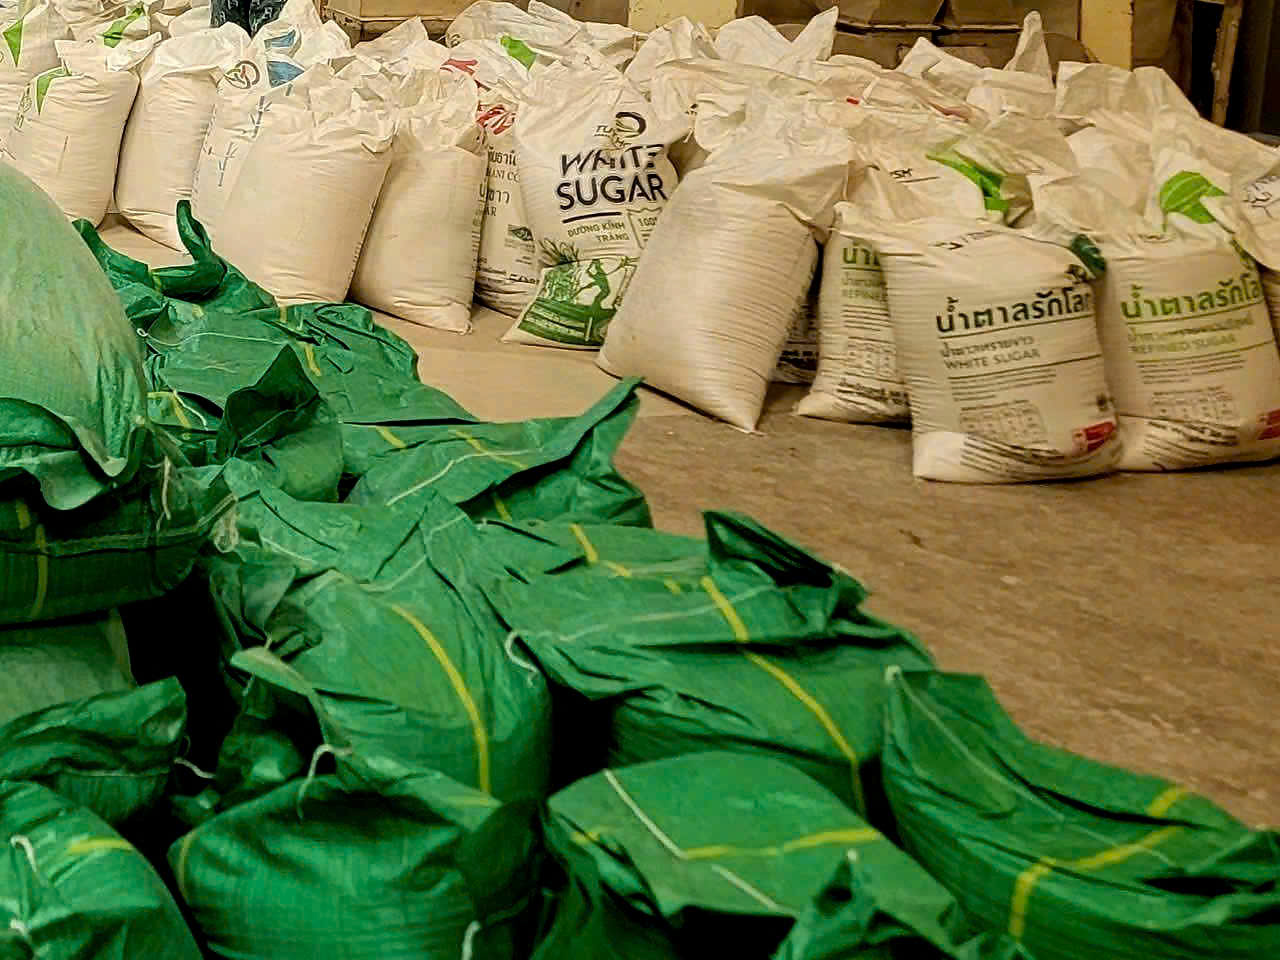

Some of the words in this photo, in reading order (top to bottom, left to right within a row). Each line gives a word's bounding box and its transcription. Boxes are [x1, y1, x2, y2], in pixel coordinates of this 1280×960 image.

[557, 173, 667, 211] SUGAR
[944, 355, 989, 369] WHITE
[994, 348, 1041, 365] SUGAR
